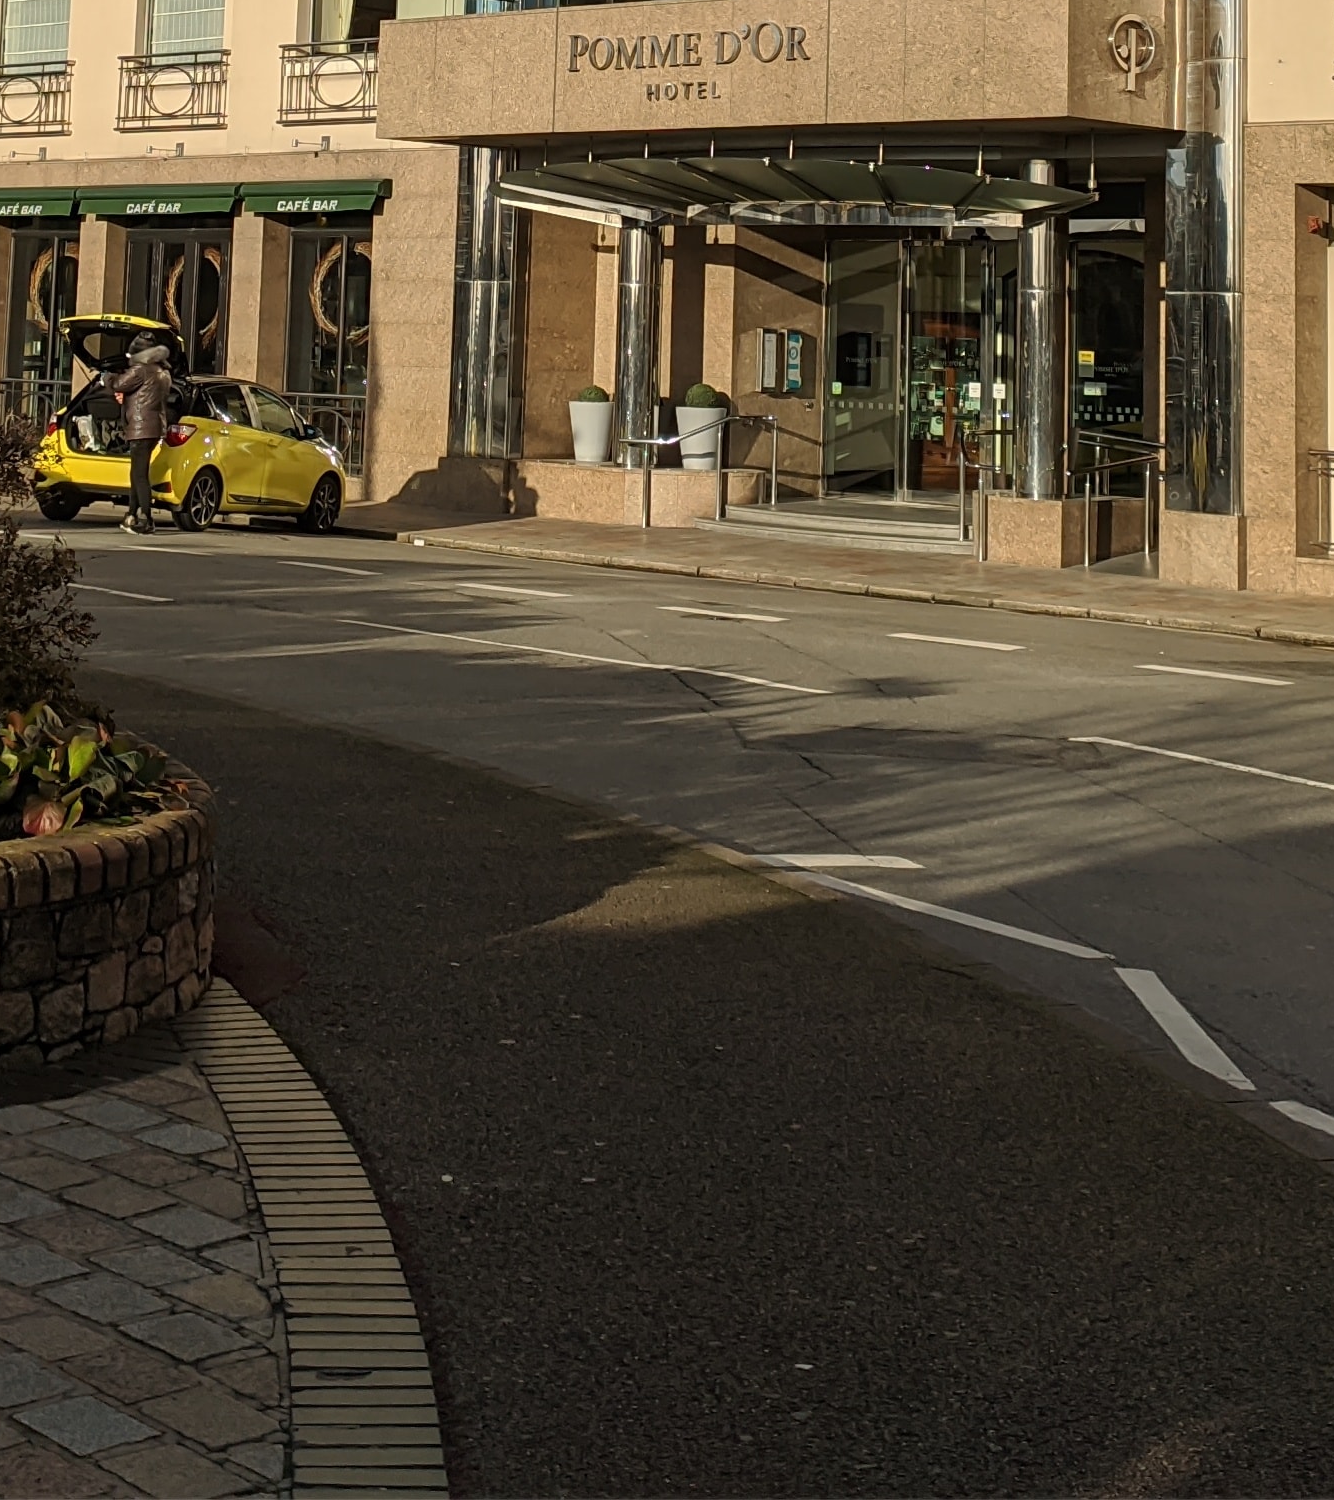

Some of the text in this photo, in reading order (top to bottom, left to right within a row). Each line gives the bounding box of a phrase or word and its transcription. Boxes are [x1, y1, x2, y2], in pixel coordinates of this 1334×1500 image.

[567, 21, 812, 73] POMME D'OR
[645, 81, 722, 102] HOTEL
[20, 204, 43, 216] BAR
[126, 200, 182, 214] CAFÉ BAR
[276, 197, 339, 212] CAFÉ BAR
